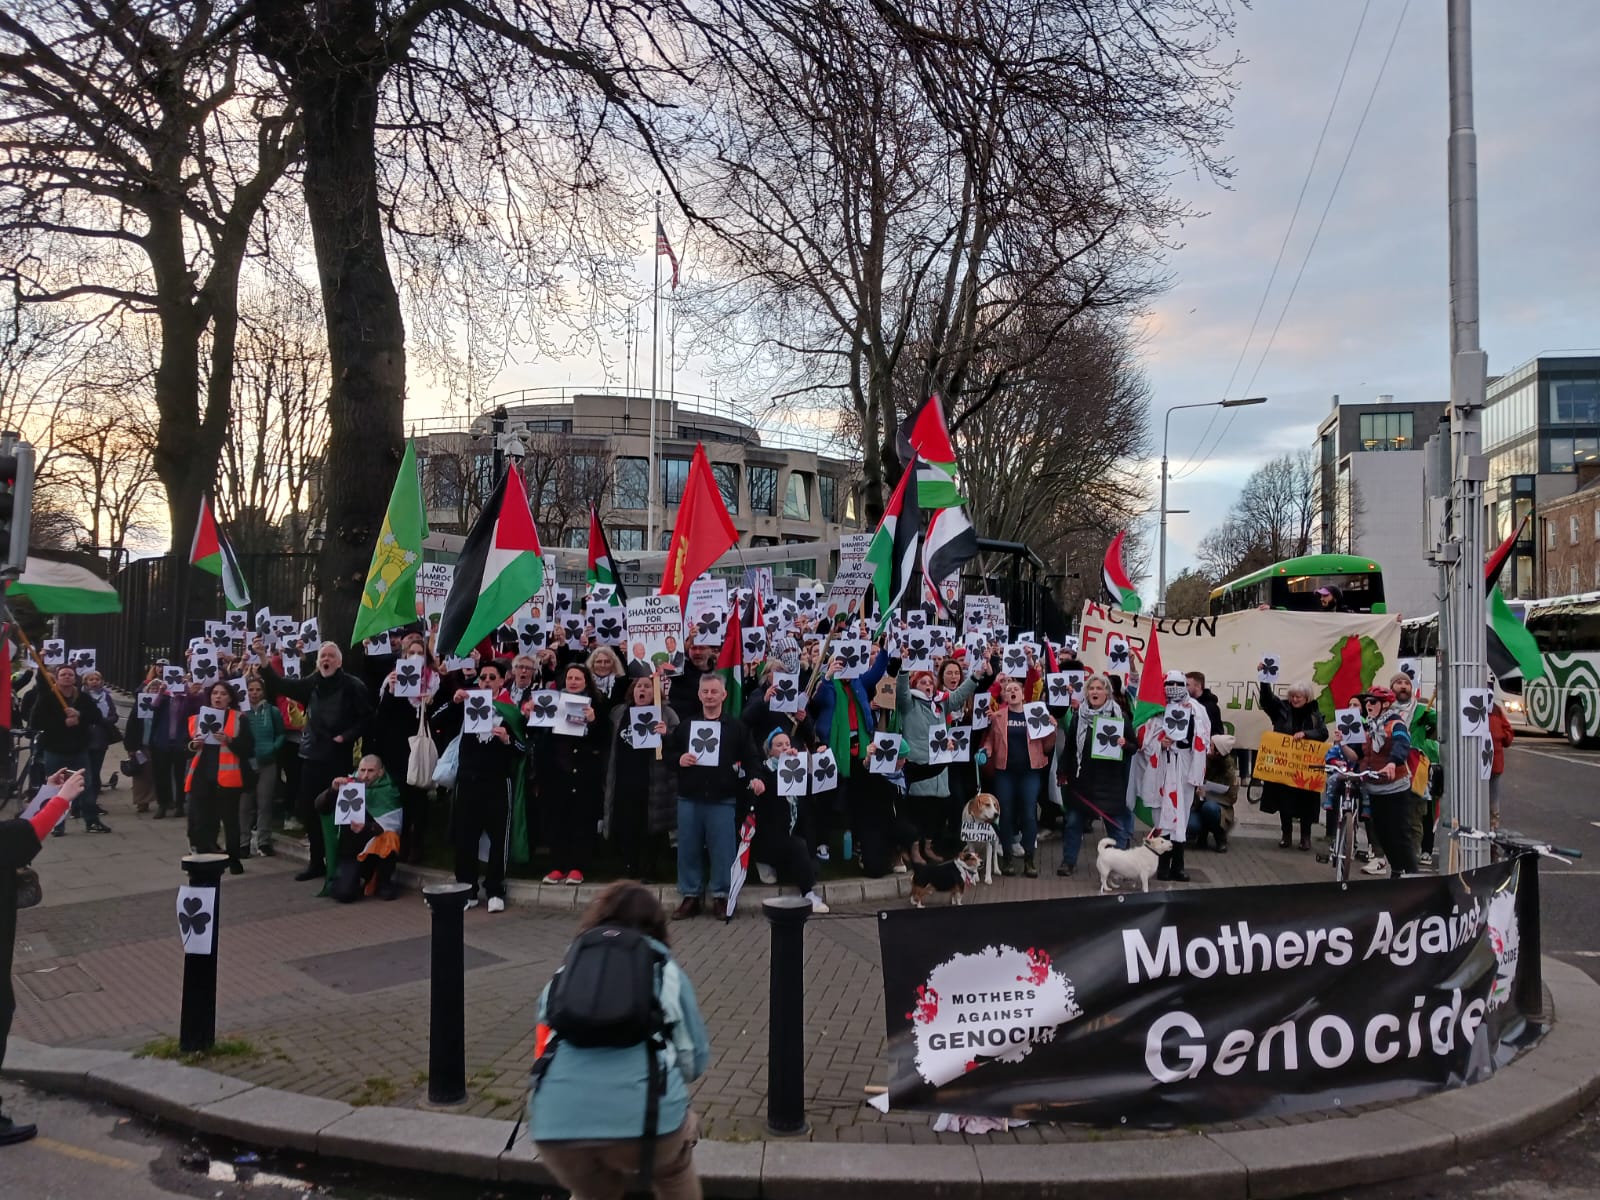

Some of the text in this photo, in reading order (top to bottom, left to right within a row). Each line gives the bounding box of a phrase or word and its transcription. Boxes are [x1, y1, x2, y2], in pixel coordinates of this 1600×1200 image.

[431, 565, 447, 574] NO
[645, 597, 661, 606] NO
[628, 605, 680, 617] SHAMROCKS
[646, 615, 662, 623] FOR
[629, 623, 680, 633] GENOCIDE JOE
[1281, 736, 1322, 754] BIDEN!
[1122, 896, 1481, 984] Mothers Against
[952, 989, 1036, 1005] MOTHERS
[957, 1007, 1035, 1024] AGAINST
[1145, 988, 1486, 1084] Genocide
